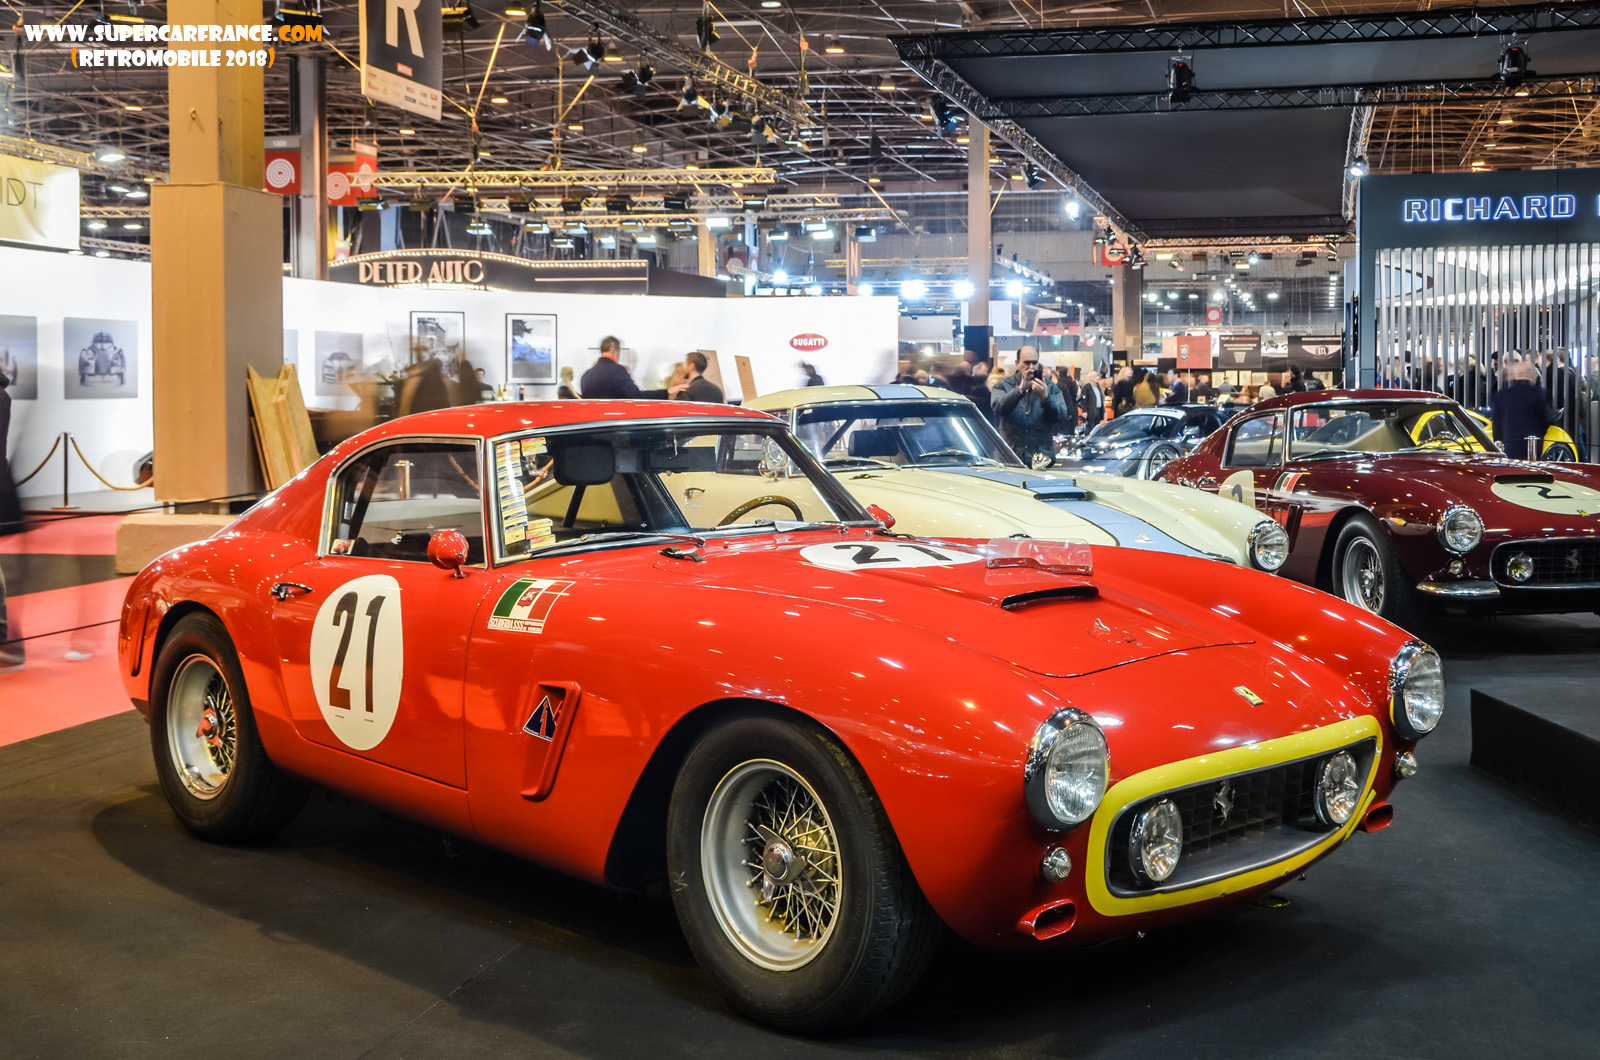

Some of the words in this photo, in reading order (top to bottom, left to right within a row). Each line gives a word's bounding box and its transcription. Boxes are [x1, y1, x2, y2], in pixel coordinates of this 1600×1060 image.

[1404, 194, 1576, 222] RICHARD
[358, 261, 423, 283] PETER
[427, 260, 484, 283] AUTO
[793, 338, 825, 346] BUGATTI
[1516, 484, 1573, 499] 2
[833, 544, 952, 564] 21
[328, 591, 386, 713] 21
